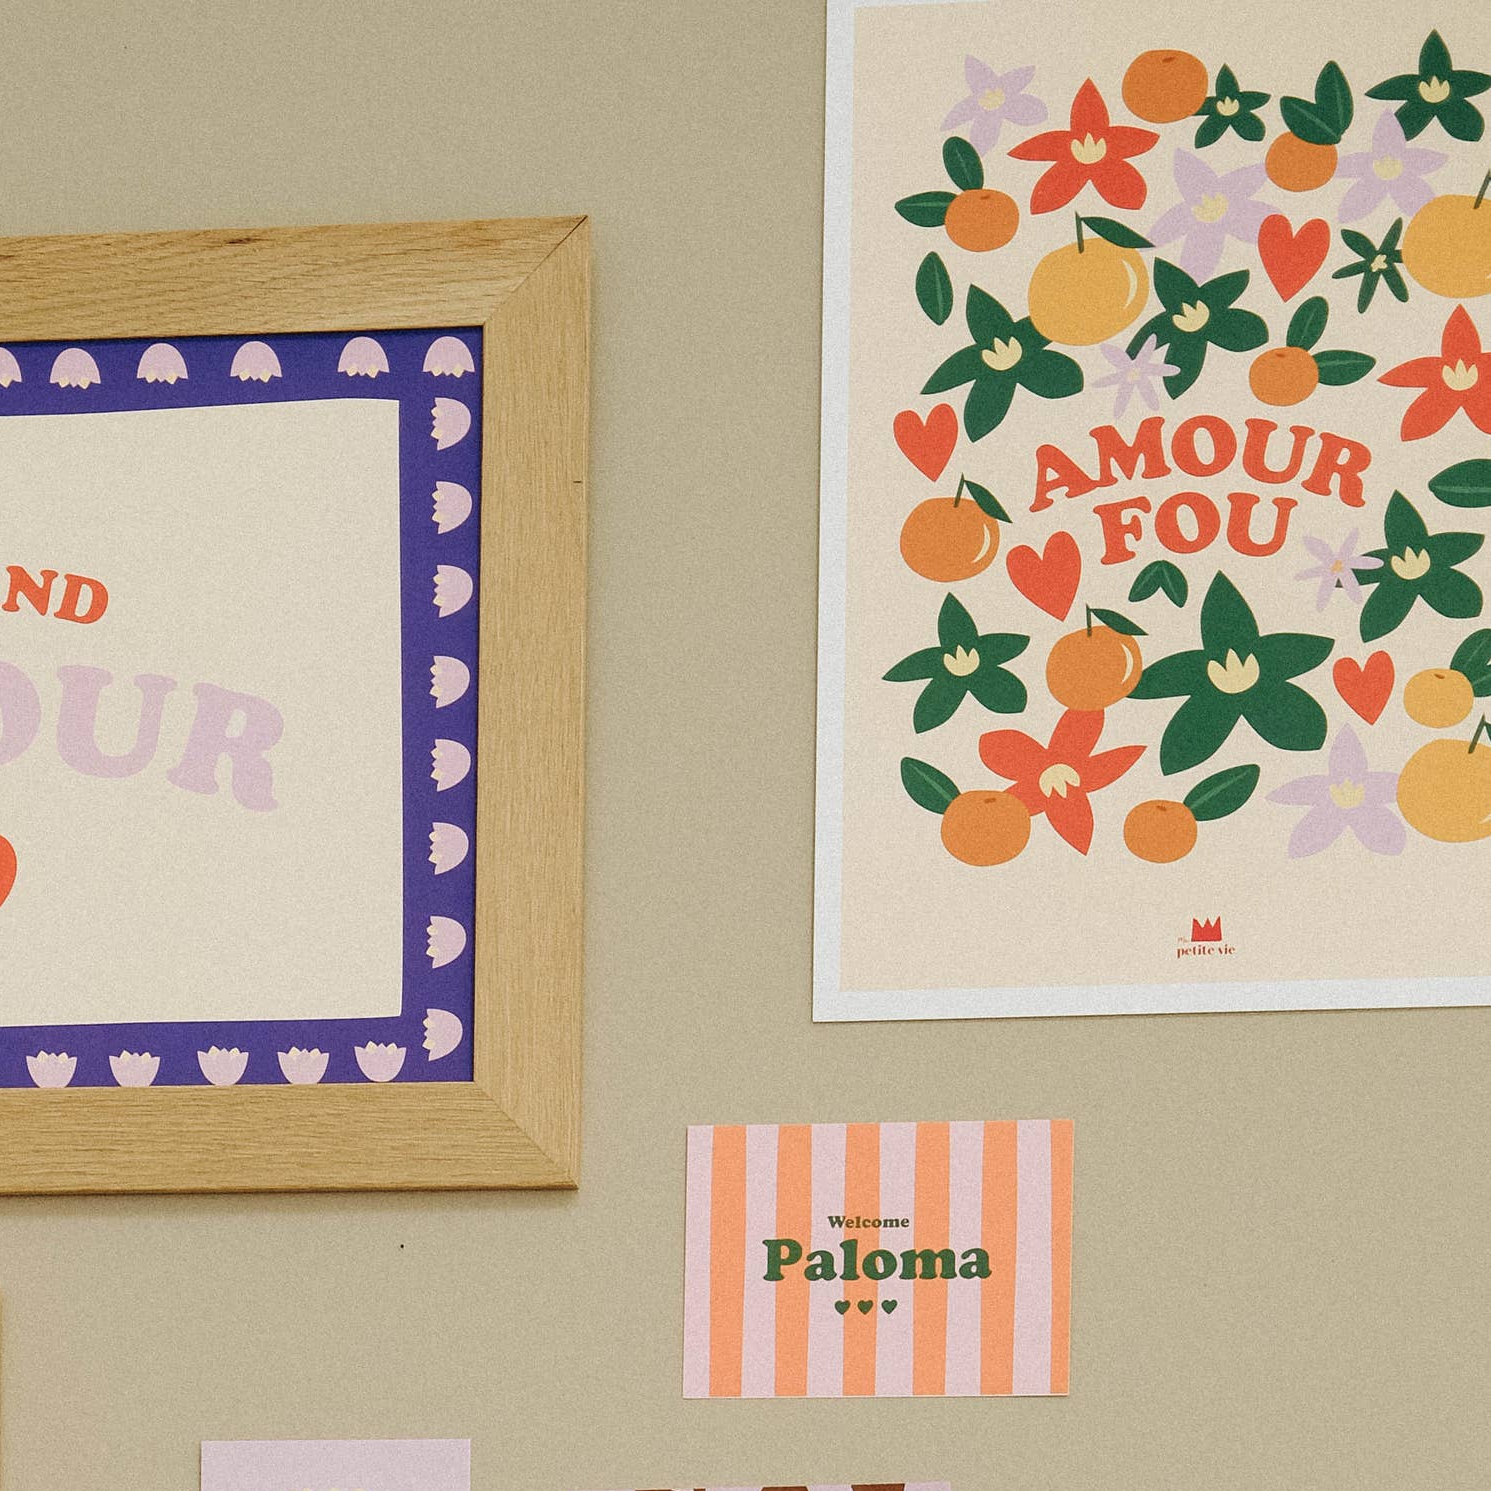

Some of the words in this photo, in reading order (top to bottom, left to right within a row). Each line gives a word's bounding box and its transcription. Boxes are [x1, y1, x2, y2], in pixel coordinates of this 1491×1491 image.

[1029, 415, 1372, 509] AMOUR
[1097, 490, 1297, 566] FOU
[1176, 944, 1215, 959] petite
[1217, 943, 1236, 956] vie
[827, 1213, 910, 1230] Welcome
[762, 1239, 993, 1283] Paloma
